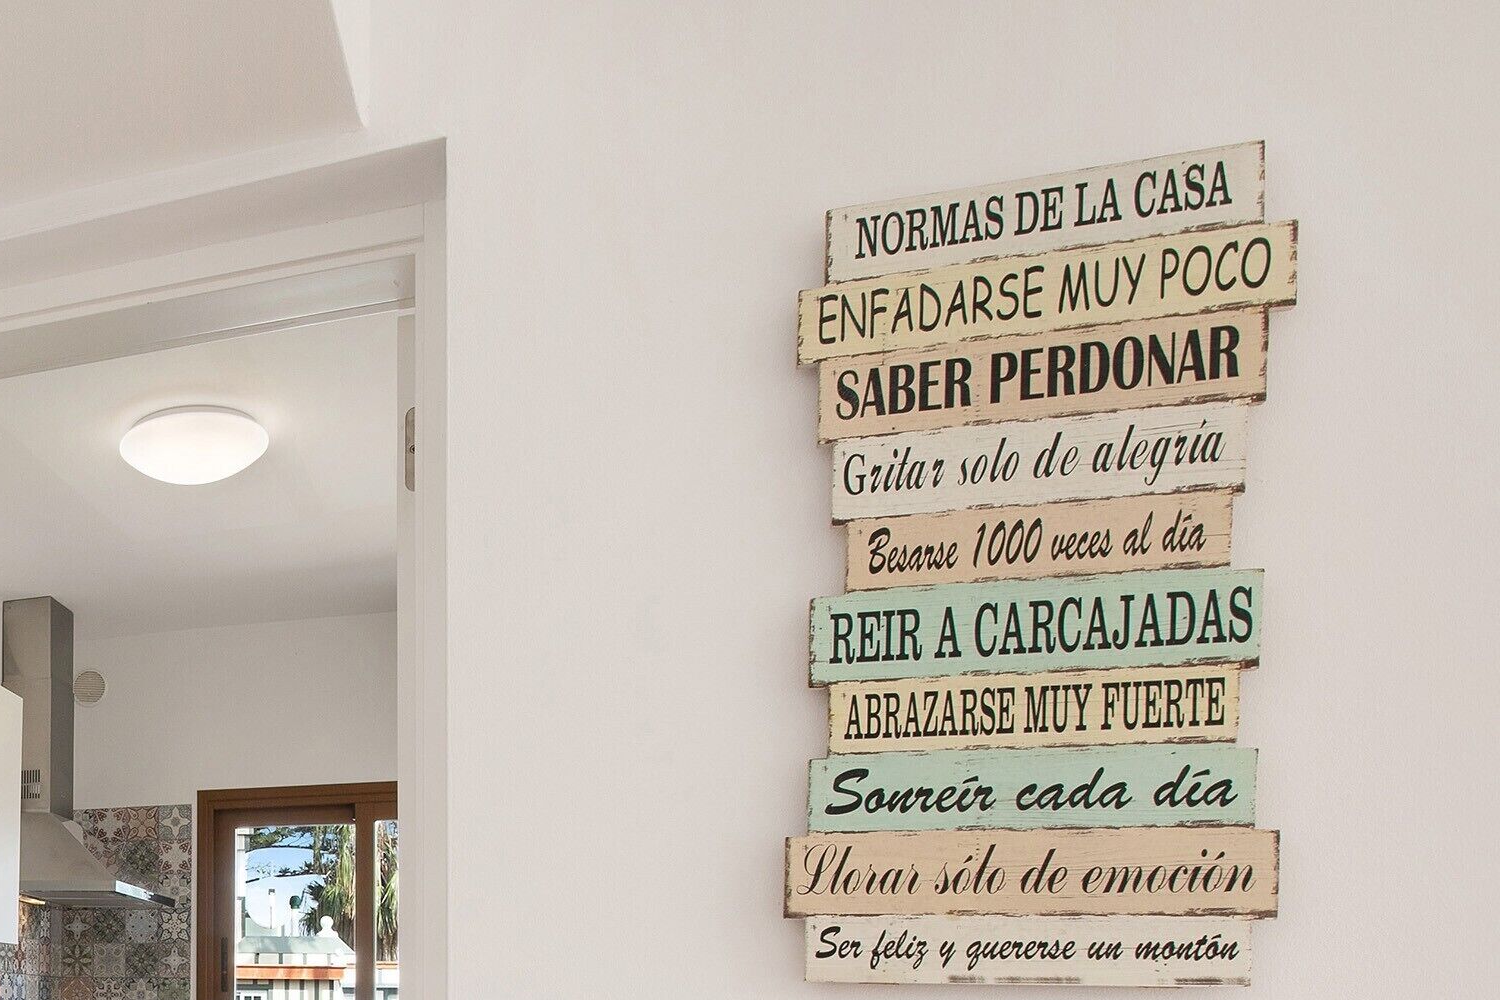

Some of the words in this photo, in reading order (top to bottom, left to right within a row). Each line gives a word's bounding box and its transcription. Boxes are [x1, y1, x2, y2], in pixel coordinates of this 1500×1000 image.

[854, 194, 1005, 261] NORMAS
[1014, 187, 1064, 234] DE
[1074, 178, 1122, 225] LA
[1133, 160, 1233, 218] CASA
[818, 266, 1045, 344] ENFADARSE
[1058, 253, 1147, 313] MUY
[1160, 236, 1272, 297] POCO
[835, 356, 972, 421] SABER
[989, 326, 1240, 404] PERDONAR
[842, 443, 946, 495] Gritar
[957, 438, 1021, 487] solo
[1032, 432, 1079, 478] de
[1090, 419, 1226, 486] alegría
[868, 526, 958, 574] Besarse
[972, 517, 1042, 569] 1000
[1050, 527, 1112, 560] veces
[1123, 511, 1154, 555] al
[1161, 509, 1206, 553] día
[829, 608, 923, 664] REIR
[934, 607, 962, 659] A
[974, 585, 1254, 657] CARCAJADAS
[843, 687, 1016, 740] ABRAZARSE
[1023, 684, 1092, 733] MUY
[1100, 677, 1226, 730] FUERTE
[824, 768, 997, 816] Sonreír
[1015, 767, 1134, 811] cada
[1152, 764, 1239, 809] día
[795, 842, 923, 897] Llorar
[934, 843, 1006, 896] sólo
[1019, 847, 1068, 895] de
[1080, 847, 1259, 895] emoción
[815, 925, 863, 960] Ser
[869, 924, 929, 970] feliz
[939, 943, 957, 969] y
[965, 936, 1077, 972] quererse
[1087, 940, 1123, 961] un
[1134, 933, 1240, 962] montón
